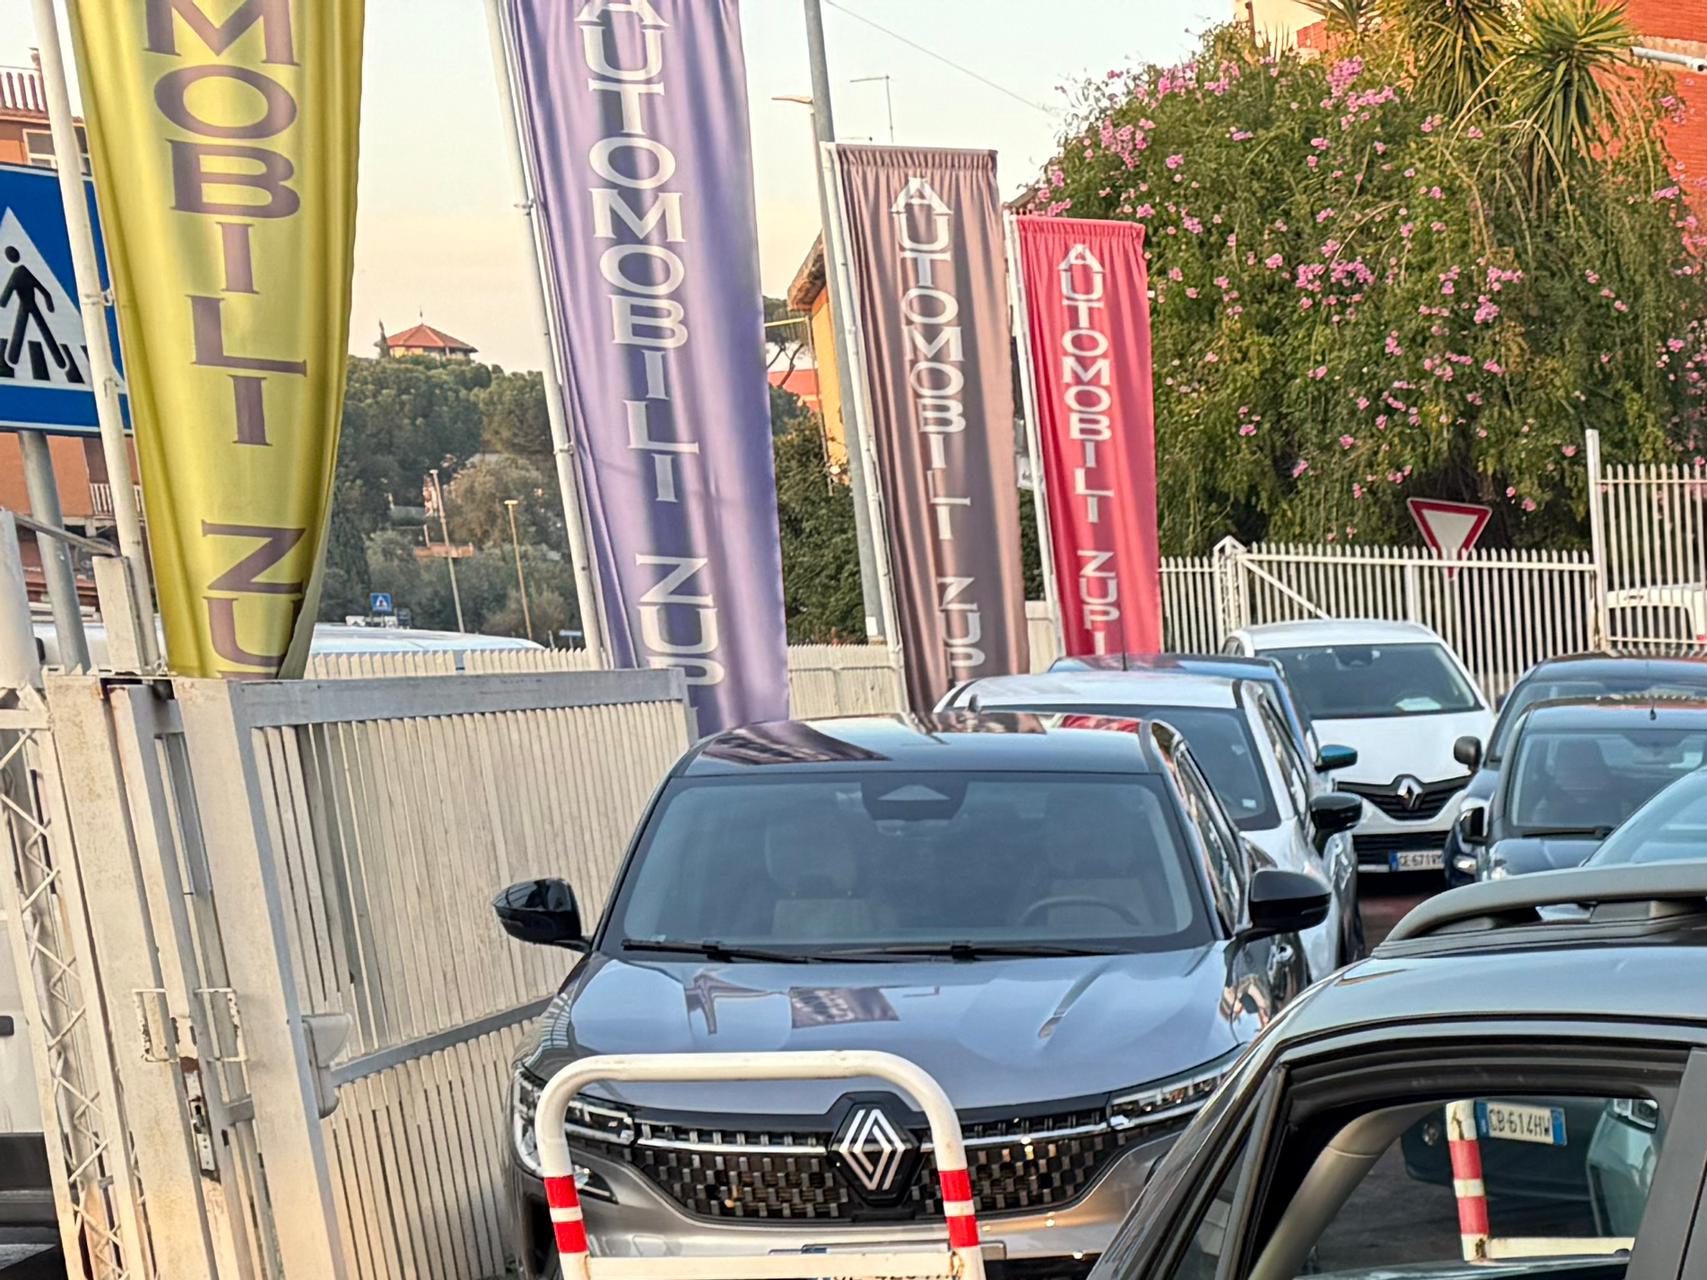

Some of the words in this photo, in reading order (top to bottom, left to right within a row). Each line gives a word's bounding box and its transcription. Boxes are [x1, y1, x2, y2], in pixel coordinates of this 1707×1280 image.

[891, 177, 971, 540] AUTOMOBILI
[1057, 243, 1115, 524] AUTOMOBILI
[201, 519, 306, 679] ZU
[1076, 549, 1120, 655] ZUPI
